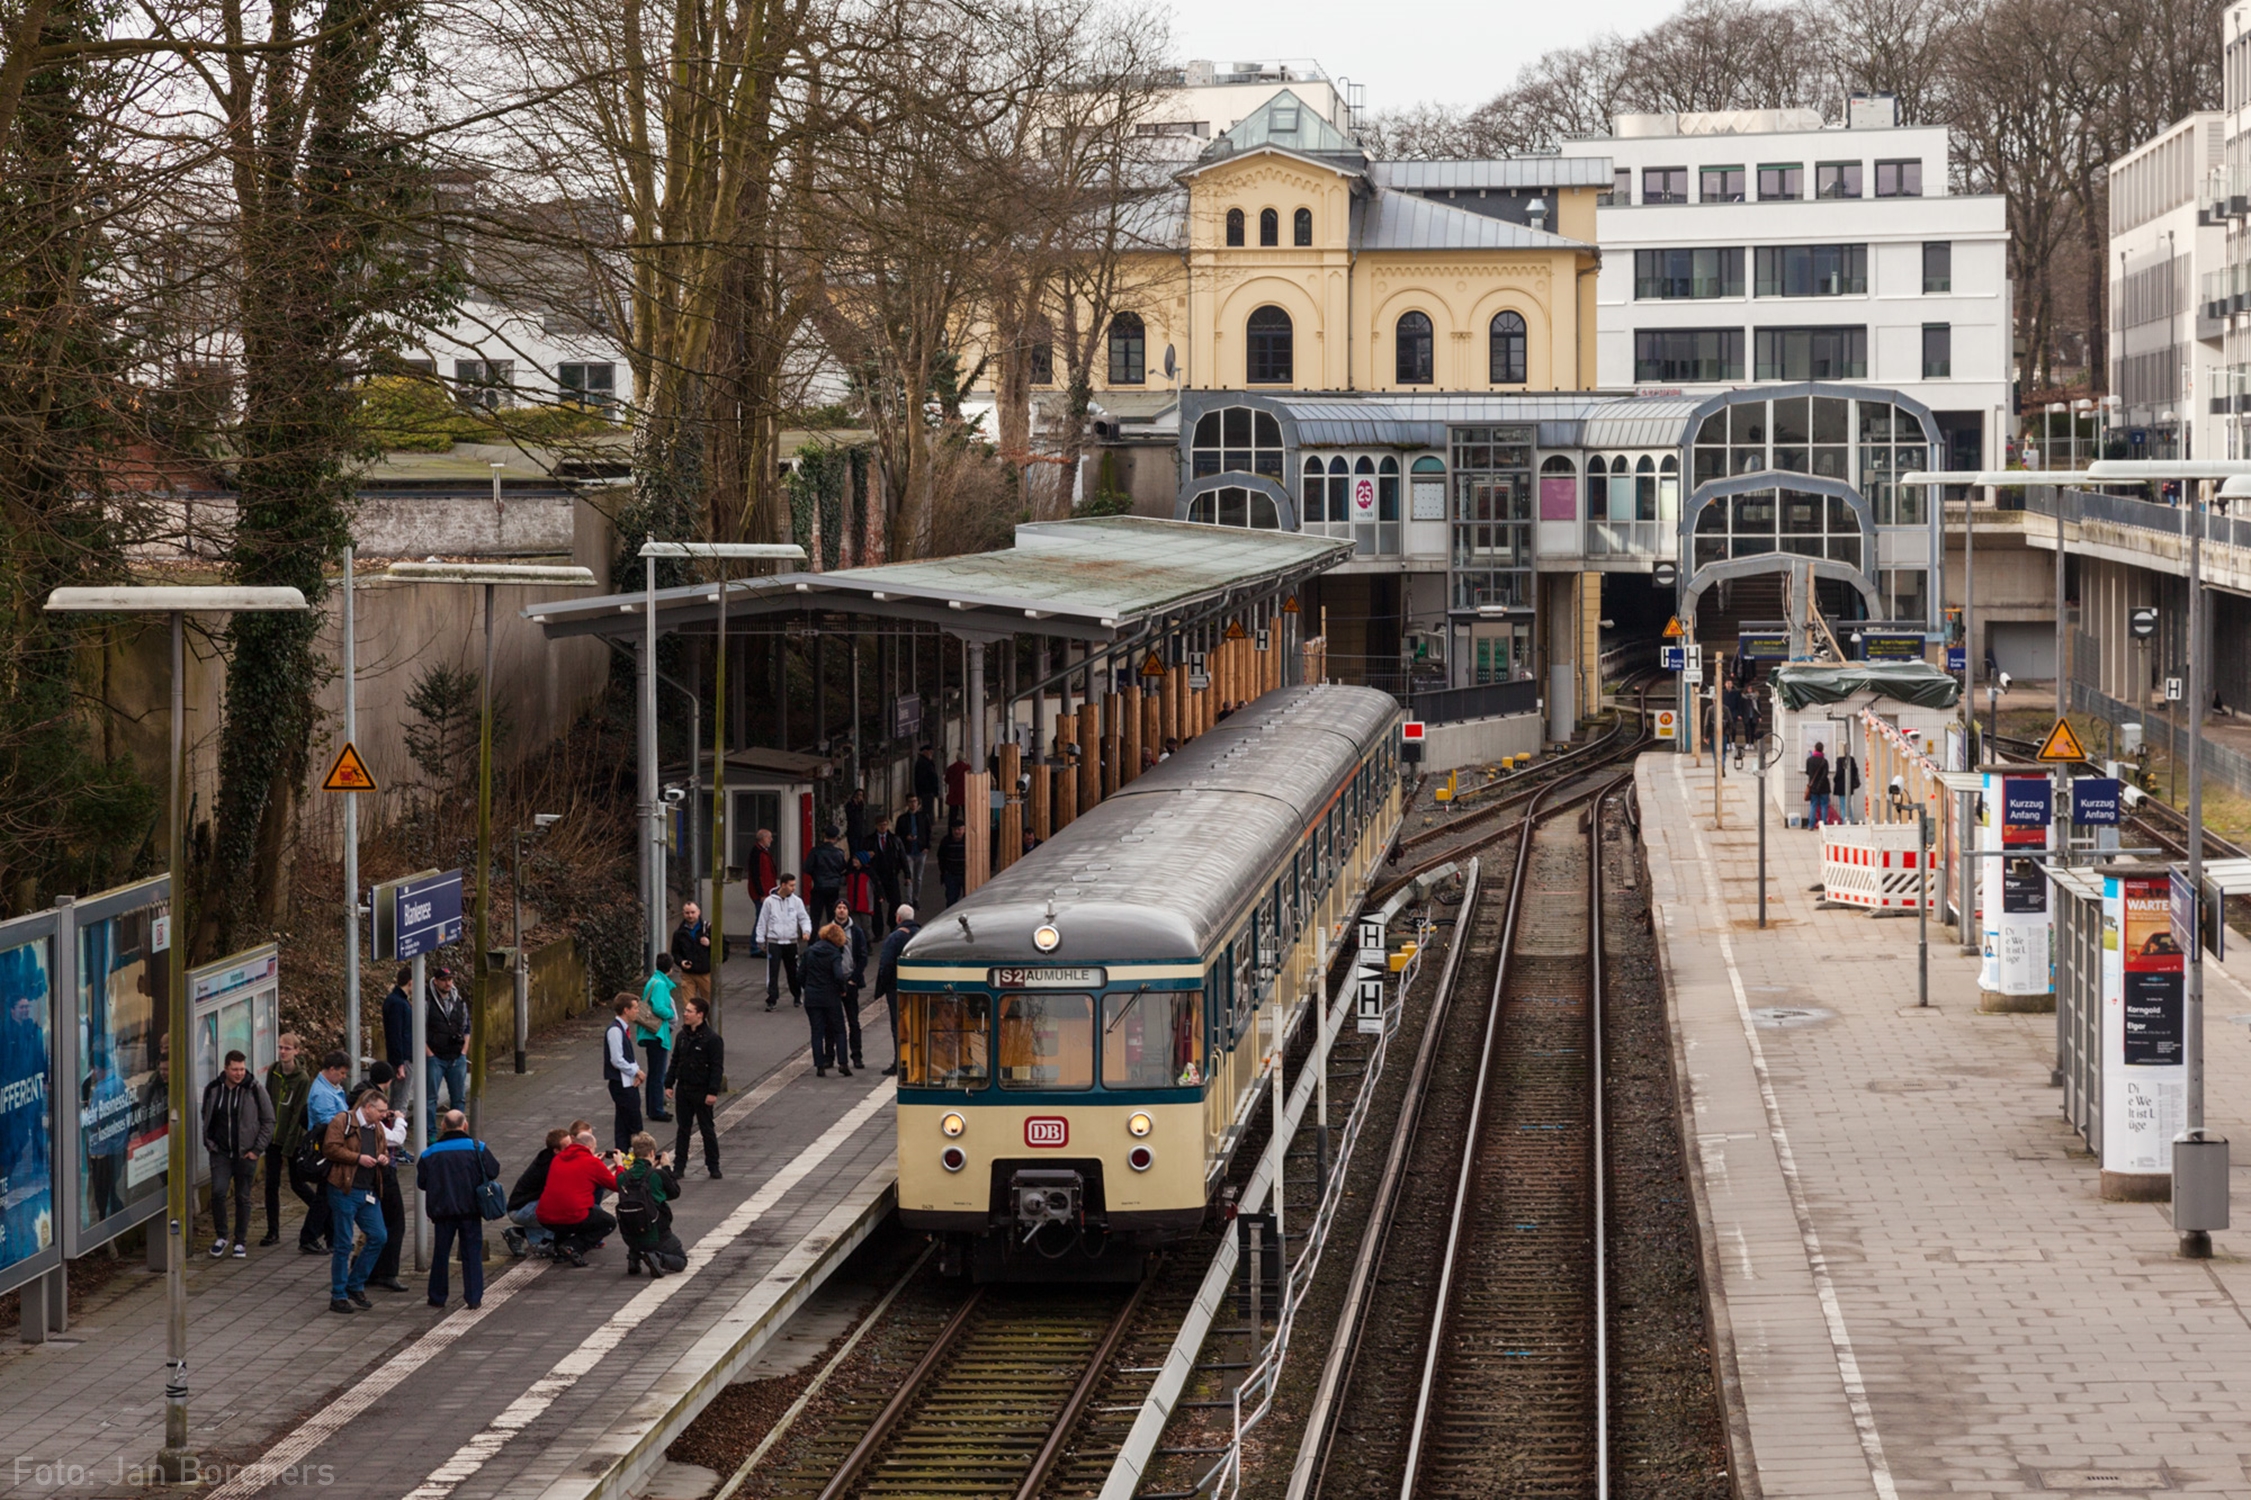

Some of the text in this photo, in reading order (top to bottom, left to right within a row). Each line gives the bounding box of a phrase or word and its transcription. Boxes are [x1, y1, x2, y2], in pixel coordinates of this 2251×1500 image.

[1358, 486, 1372, 502] 25
[1257, 631, 1268, 649] H
[1191, 654, 1204, 675] H
[1686, 647, 1699, 668] H
[2168, 680, 2179, 698] H
[2010, 799, 2044, 810] Kurzzug
[2081, 799, 2115, 810] Kurzzug
[2010, 811, 2040, 821] Anfang
[2085, 811, 2115, 821] Anfang
[404, 901, 432, 926] Blankenese
[1364, 926, 1379, 947] H
[1001, 969, 1024, 983] S2
[1361, 984, 1379, 1014] H
[2127, 1006, 2161, 1015] Korngold
[2127, 1022, 2146, 1031] Elgar
[2128, 1082, 2139, 1094] Di
[2136, 1095, 2151, 1106] We
[1033, 1125, 1060, 1139] DB
[2128, 1120, 2146, 1132] üge
